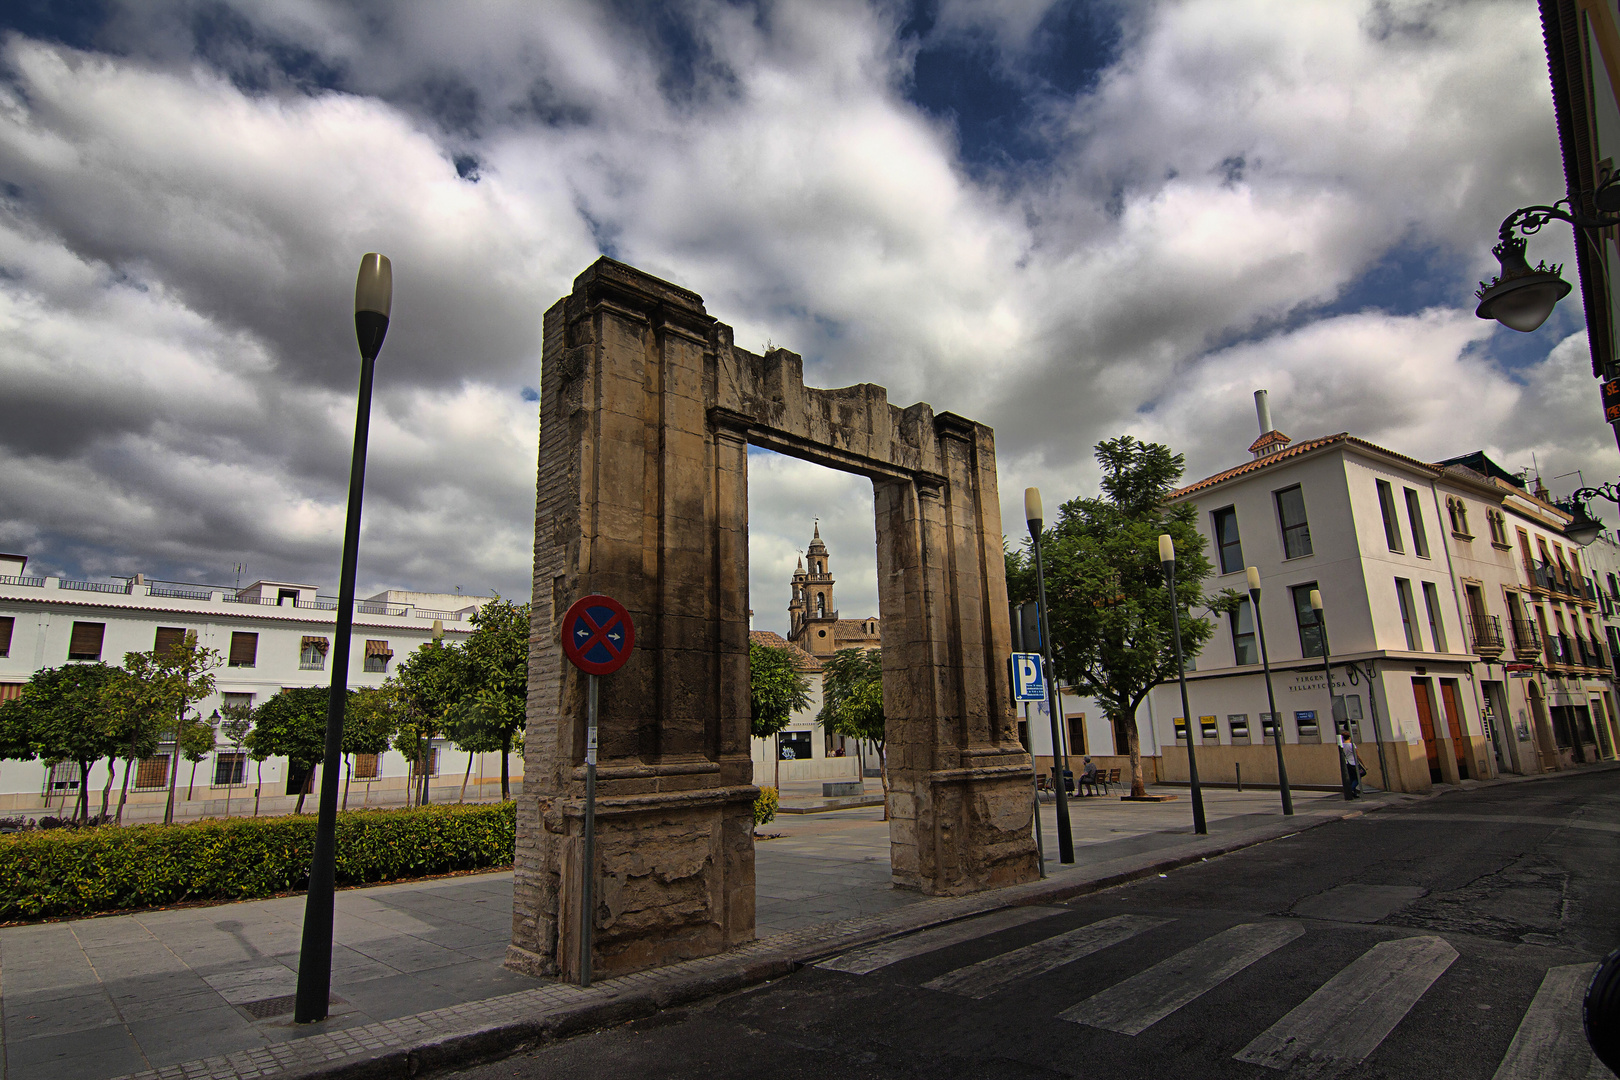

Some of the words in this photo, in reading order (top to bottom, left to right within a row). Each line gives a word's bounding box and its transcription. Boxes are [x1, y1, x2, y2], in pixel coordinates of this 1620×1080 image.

[1606, 381, 1620, 396] SE
[1018, 659, 1037, 695] P
[1289, 681, 1346, 691] VILLAVICOSA
